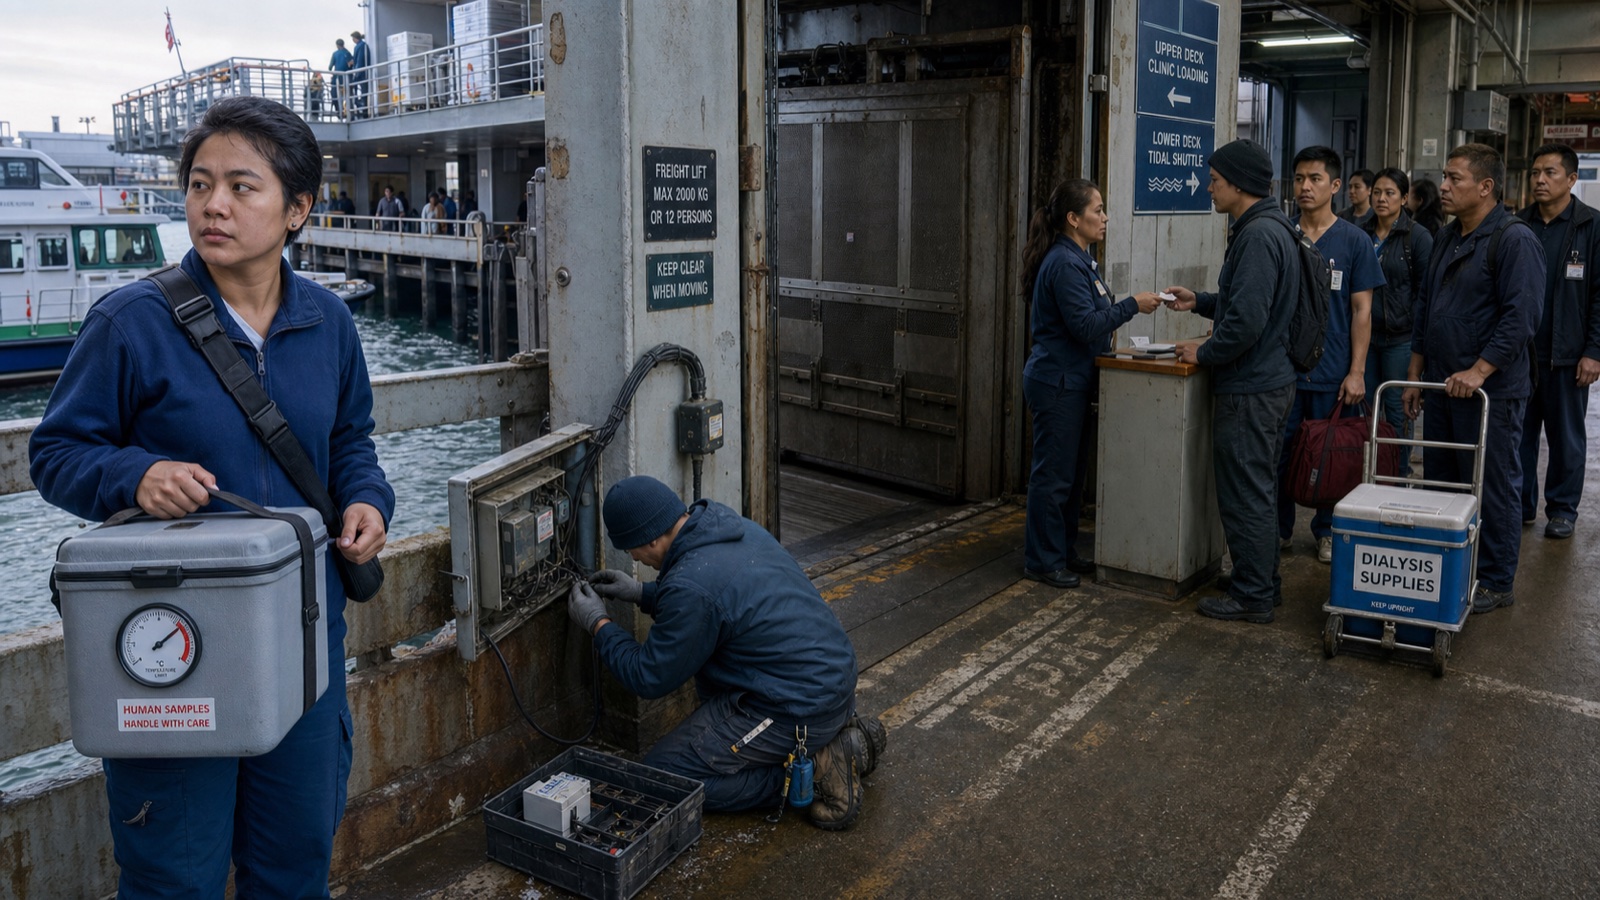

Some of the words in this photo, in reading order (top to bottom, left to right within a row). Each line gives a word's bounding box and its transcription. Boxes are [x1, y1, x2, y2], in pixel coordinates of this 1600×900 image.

[1155, 40, 1182, 60] UPPER
[1184, 47, 1204, 65] DECK
[1148, 58, 1175, 77] CLINIC
[1176, 64, 1209, 84] LOADING
[1152, 130, 1180, 148] LOWER
[1182, 134, 1201, 150] DECK
[1148, 150, 1171, 166] TIDAL
[1172, 152, 1203, 168] SHUTTLE
[655, 163, 690, 179] FREIGHT
[691, 165, 707, 180] LIFT
[653, 186, 674, 202] MAX
[675, 187, 696, 202] 2000
[697, 187, 709, 202] KG
[650, 209, 663, 225] OR
[665, 209, 675, 224] 12
[676, 209, 713, 224] PERSONS
[657, 261, 679, 277] KEEP
[680, 259, 705, 276] CLEAR
[652, 283, 677, 300] WHEN
[678, 280, 709, 298] MOVING
[1362, 552, 1434, 573] DIALYSIS
[1360, 570, 1435, 593] SUPPLIES
[1371, 601, 1387, 609] KEEP
[123, 705, 162, 714] HUMAN
[164, 704, 210, 714] SAMPLES
[123, 719, 159, 728] HANDLE
[161, 719, 185, 728] WITH
[186, 718, 210, 728] CARE
